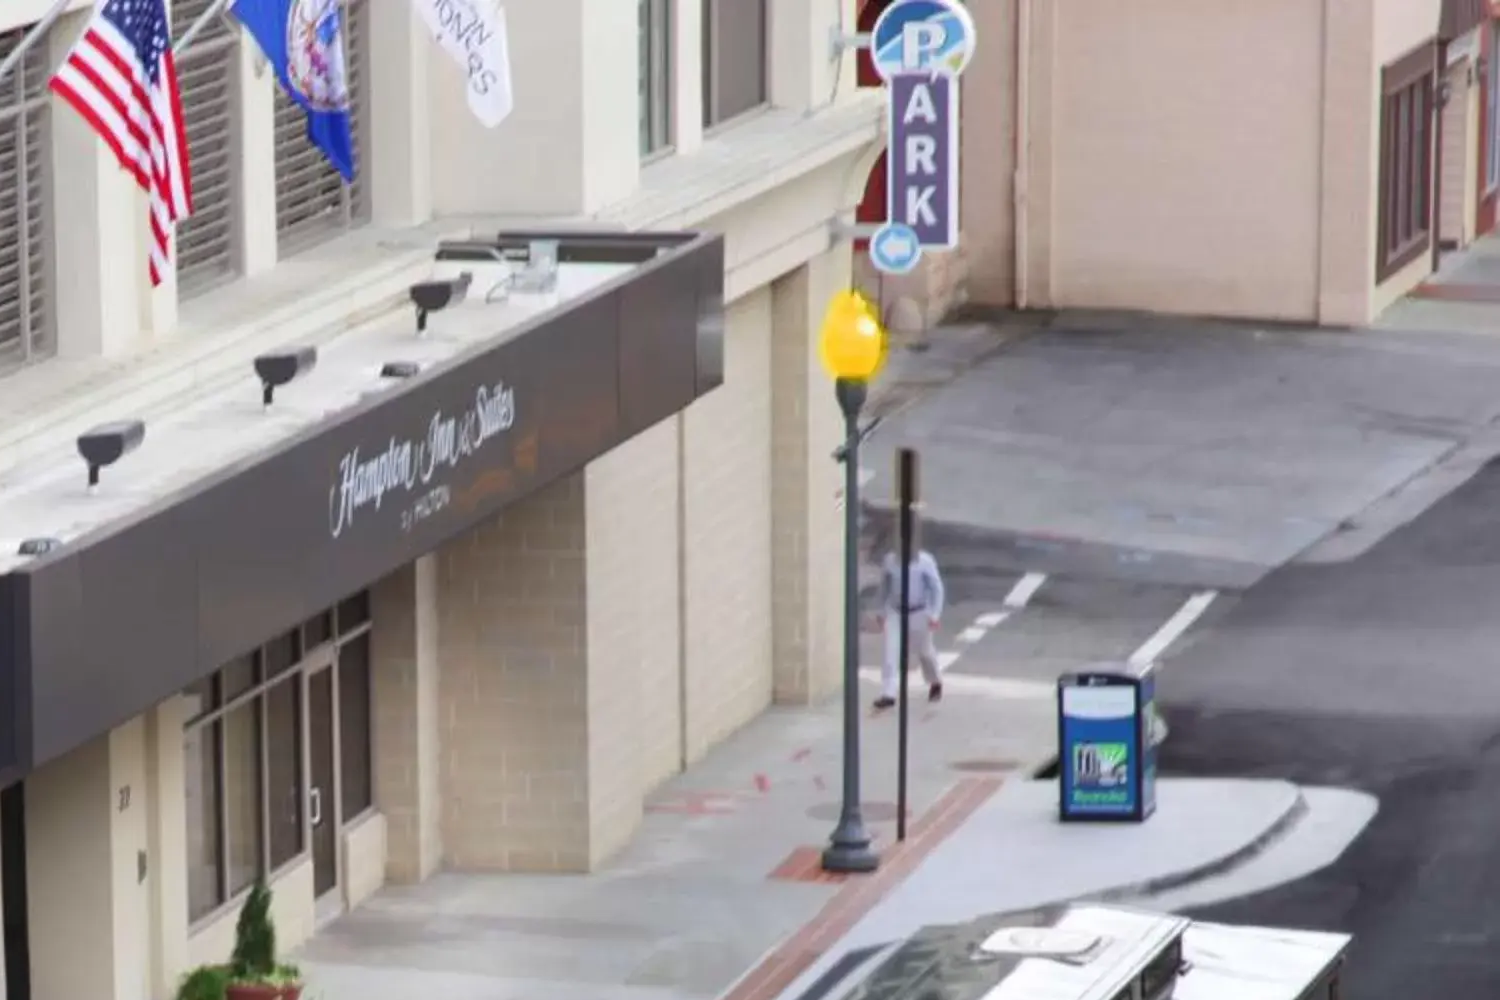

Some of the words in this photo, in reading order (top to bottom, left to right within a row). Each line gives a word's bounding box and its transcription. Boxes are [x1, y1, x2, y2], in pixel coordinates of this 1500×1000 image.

[902, 20, 946, 228] PARK
[329, 445, 418, 538] Hampton
[418, 410, 462, 484] Inn
[469, 380, 515, 449] Suites
